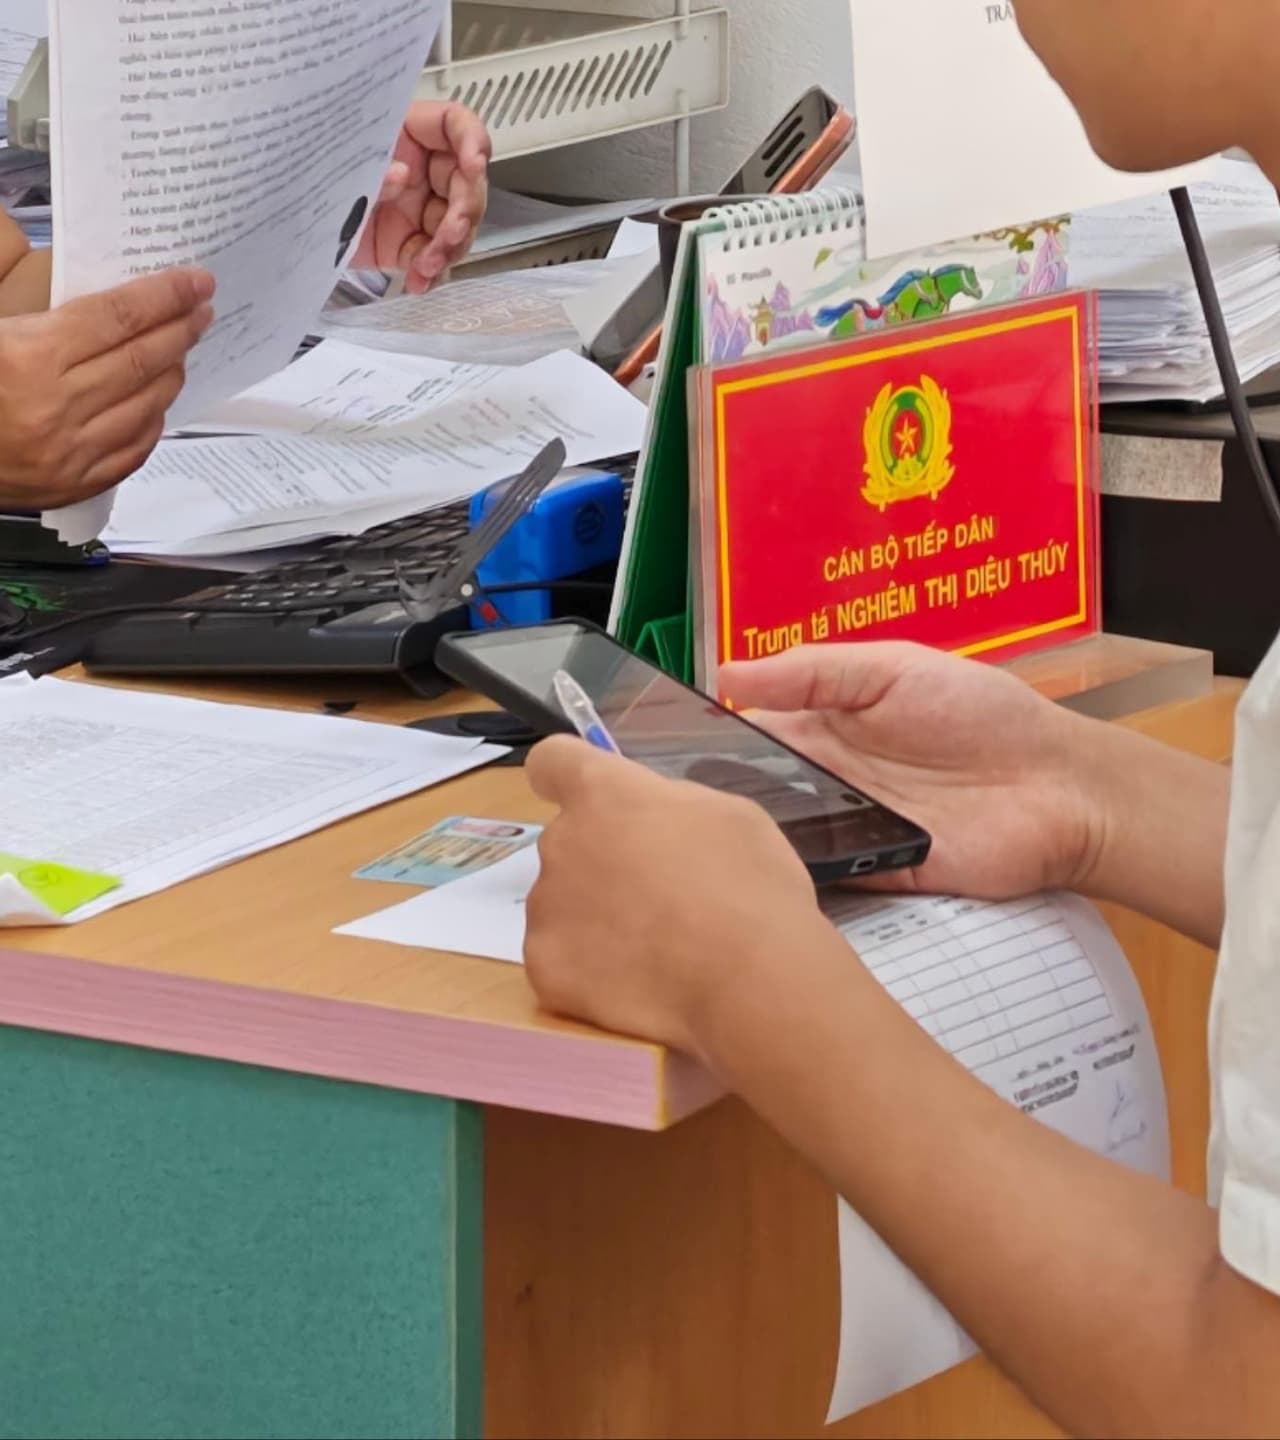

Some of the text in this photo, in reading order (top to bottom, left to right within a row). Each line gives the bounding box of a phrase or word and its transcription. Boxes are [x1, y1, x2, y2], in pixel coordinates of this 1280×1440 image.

[824, 514, 993, 582] CÁN BỘ TIẾP DÂN
[743, 538, 1068, 659] Trung tá NGHIÊM THỊ DIỆU THÚY
